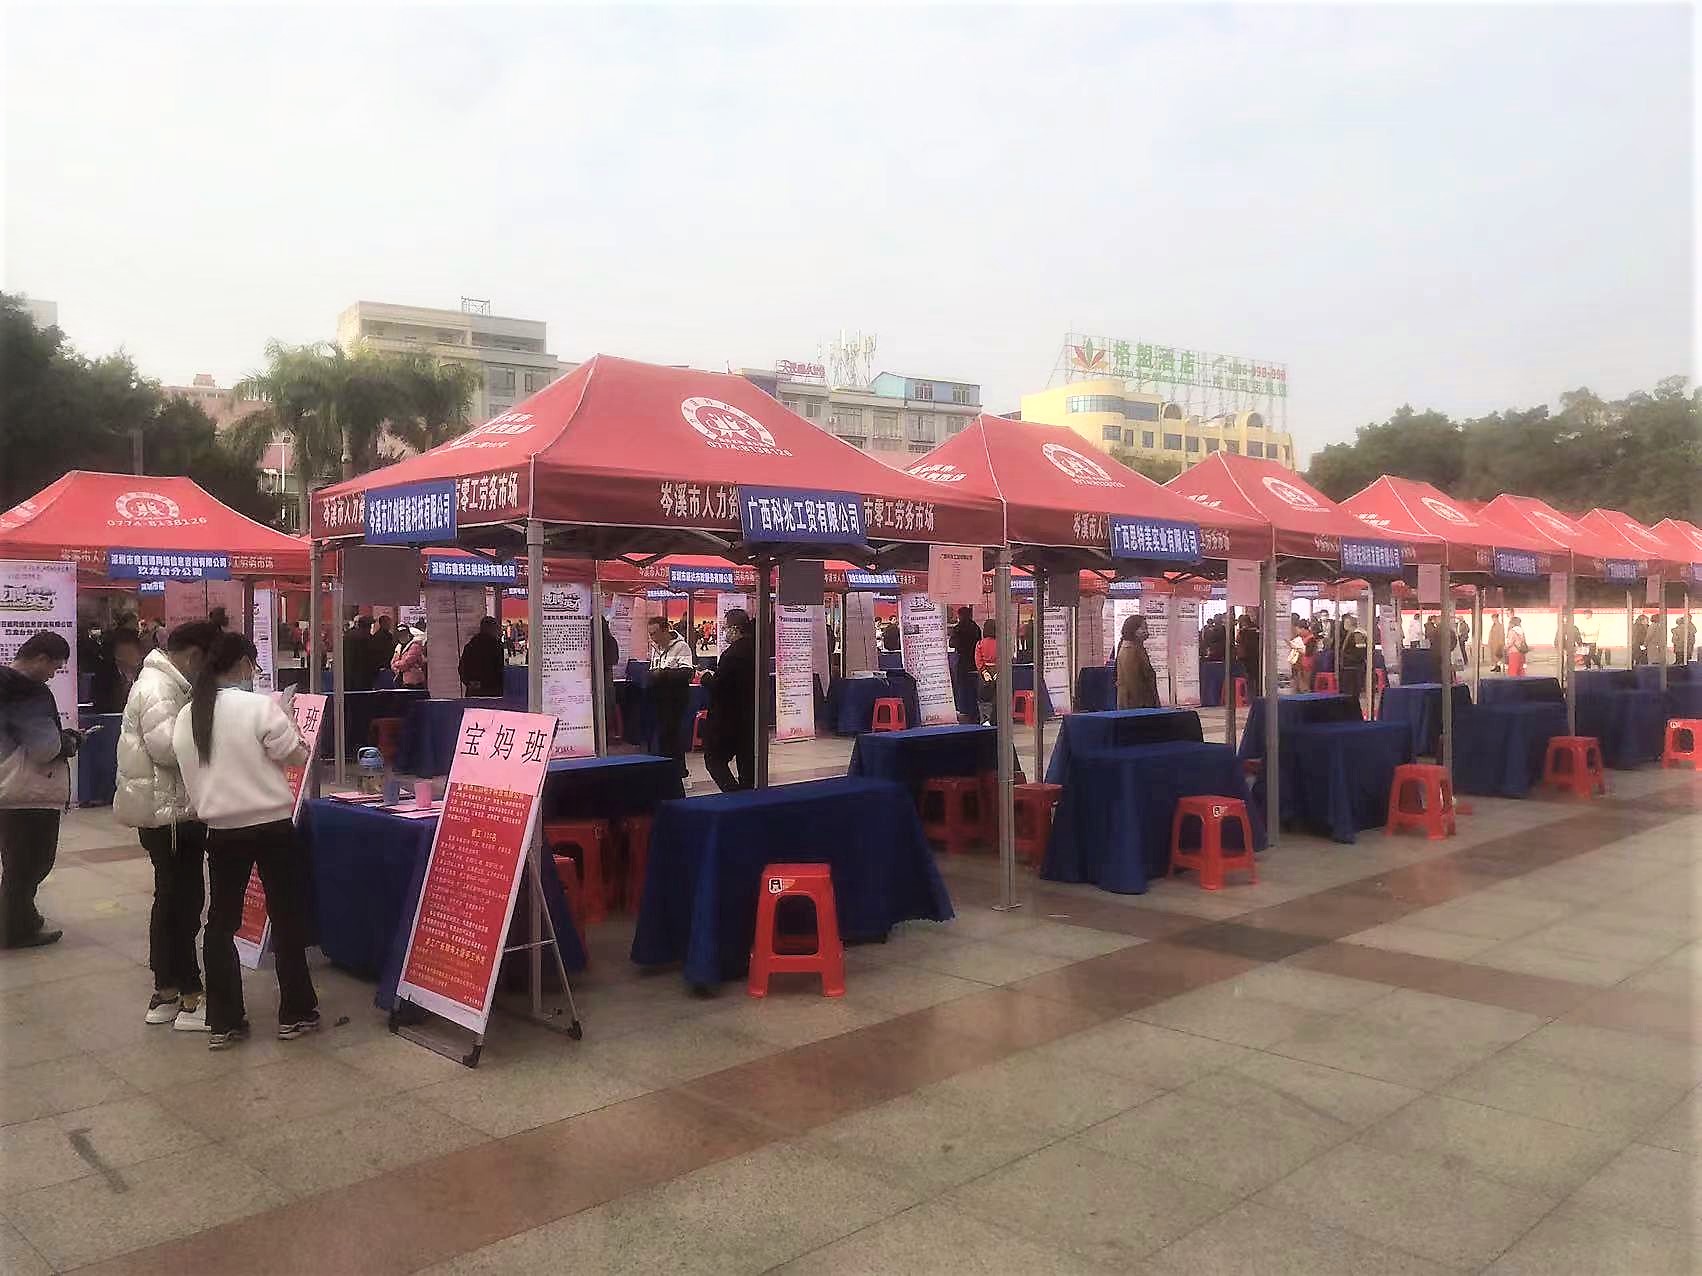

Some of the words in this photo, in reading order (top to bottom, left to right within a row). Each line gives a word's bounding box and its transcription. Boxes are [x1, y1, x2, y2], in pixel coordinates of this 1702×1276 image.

[1073, 512, 1108, 541] 岑溪市人
[459, 721, 548, 765] 宝妈班
